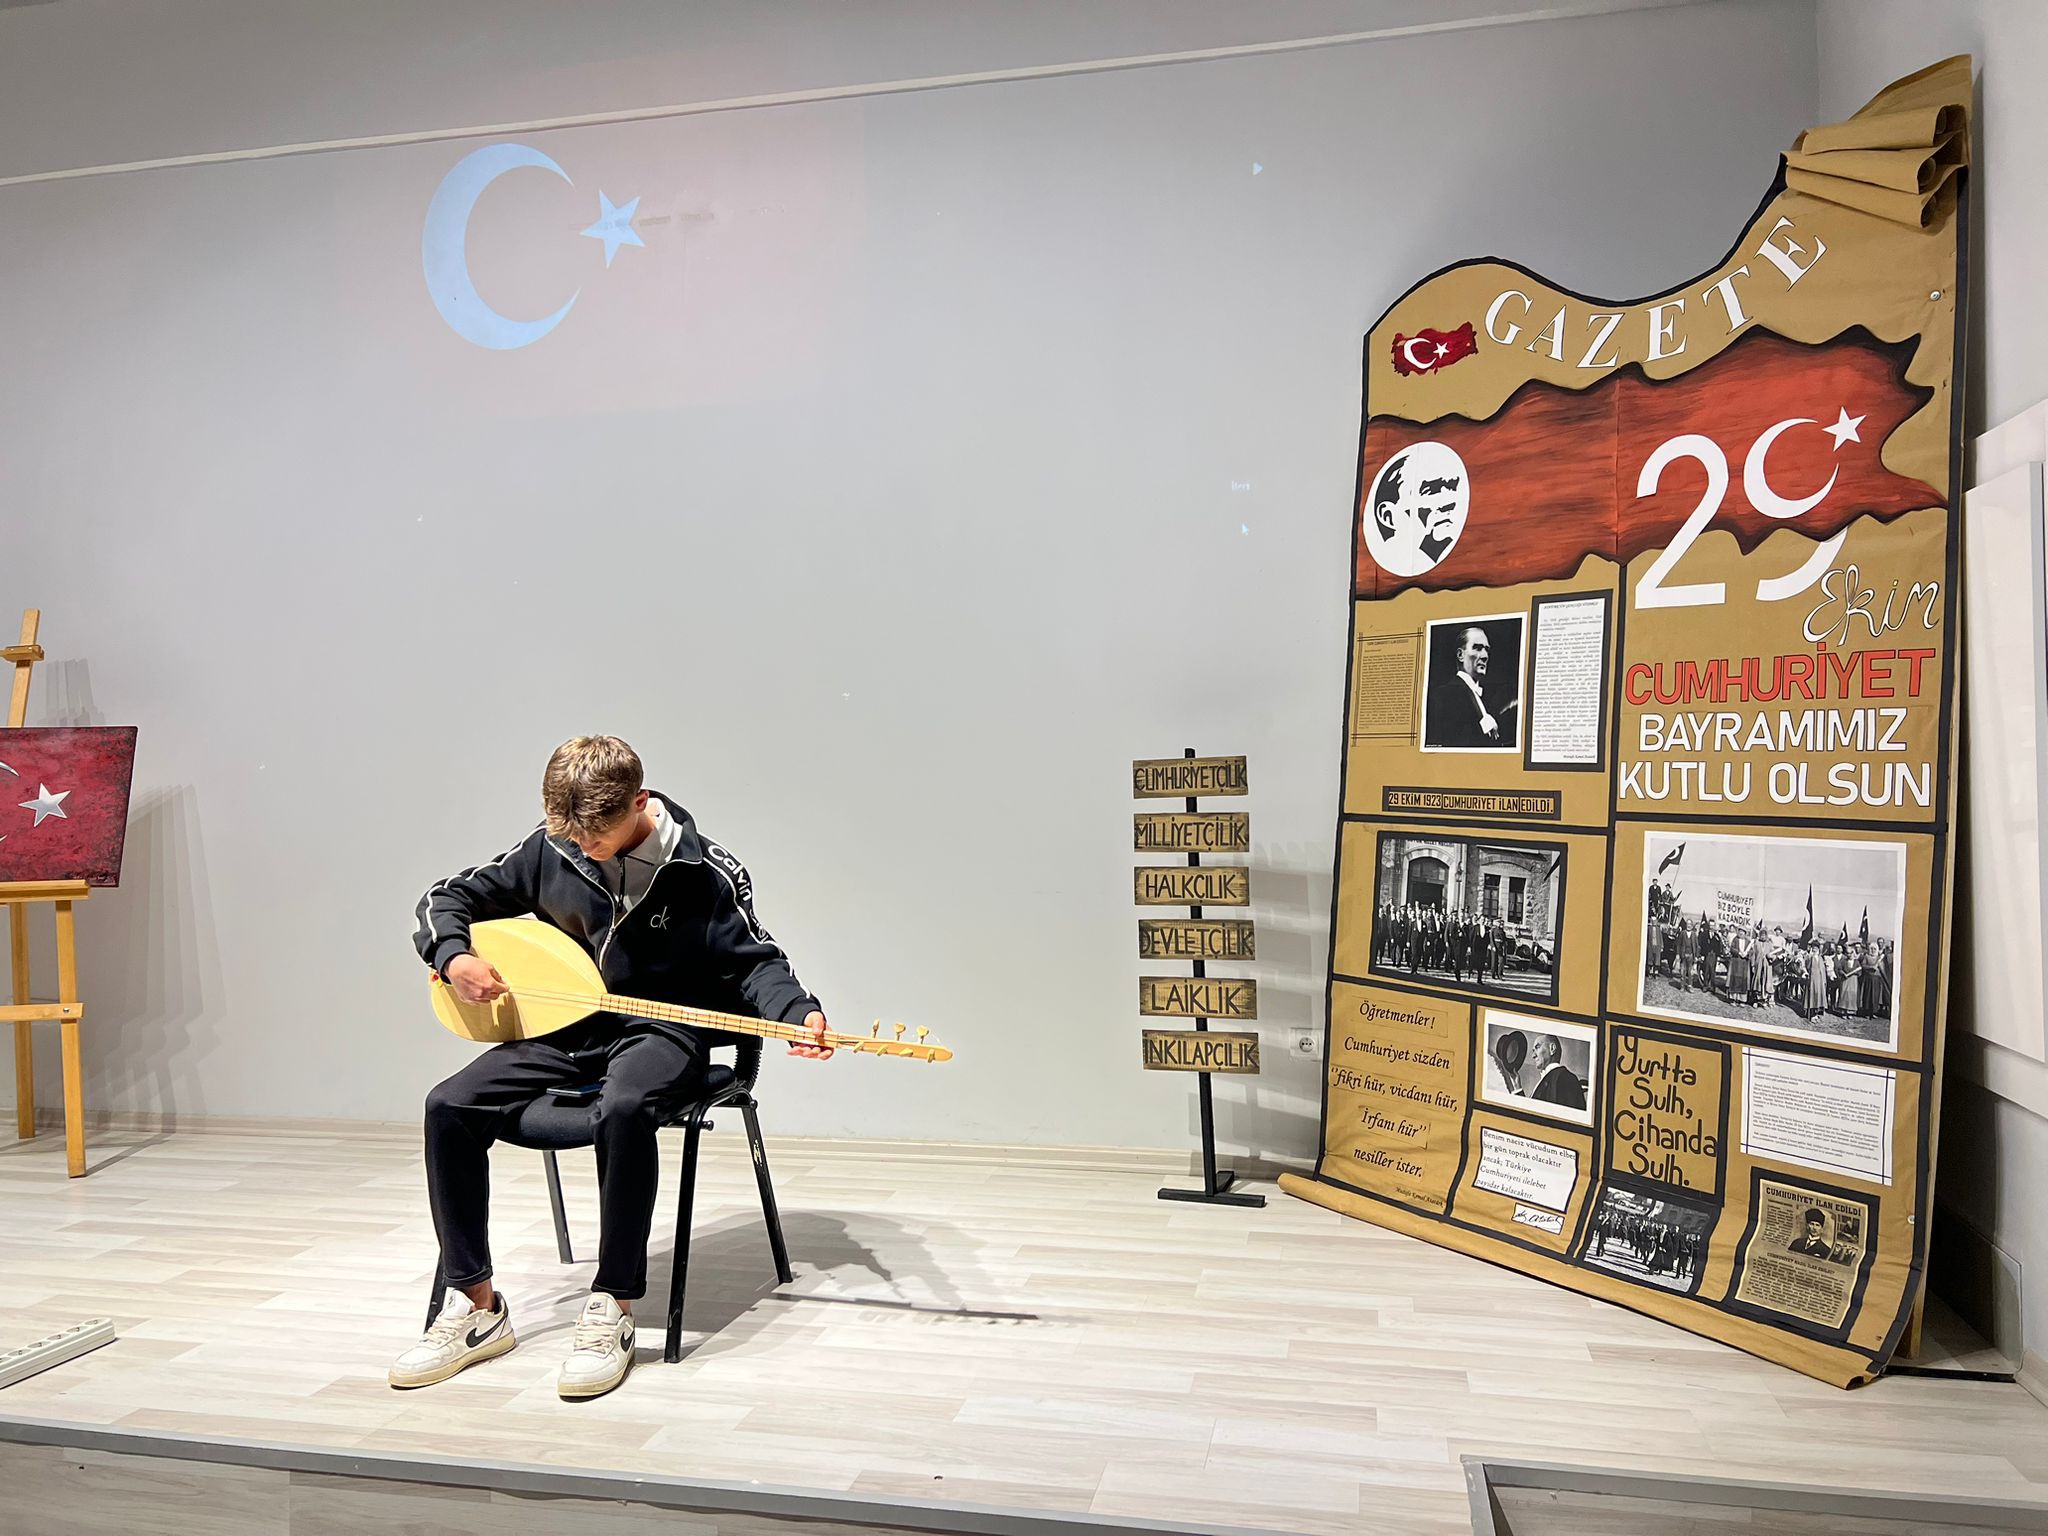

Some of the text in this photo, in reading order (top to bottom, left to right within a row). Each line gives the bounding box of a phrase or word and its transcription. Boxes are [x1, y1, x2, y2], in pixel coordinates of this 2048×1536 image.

[1483, 216, 1827, 370] GAZETE
[1625, 642, 1936, 705] CUMHURİYET
[1639, 708, 1908, 752] BAYRAMIMIZ
[1389, 793, 1399, 804] 29
[1402, 793, 1420, 805] EKİM
[1424, 794, 1441, 807] 1923
[1443, 796, 1496, 810] CUMHURİYET
[1499, 797, 1518, 811] İLAN
[1619, 761, 1931, 807] KUTLU OLSUN
[707, 845, 752, 901] Calvin
[1146, 874, 1237, 903] HALKÇILIK
[1152, 979, 1241, 1014] LAİKLİK
[1345, 1036, 1450, 1069] Cumhuriyet sizden
[1364, 1075, 1386, 1095] hür,
[1390, 1083, 1432, 1104] vicdanı
[1435, 1091, 1458, 1112] hür,
[1630, 1077, 1693, 1119] Sulh,
[1526, 1142, 1557, 1155] vücudum
[1614, 1110, 1717, 1157] Cihanda
[1354, 1148, 1422, 1177] nesiller ister.
[1509, 1149, 1530, 1160] toprak
[1628, 1143, 1690, 1186] Sulh.
[1766, 1187, 1861, 1216] CUMHURİYET İLAN EDİLDİ
